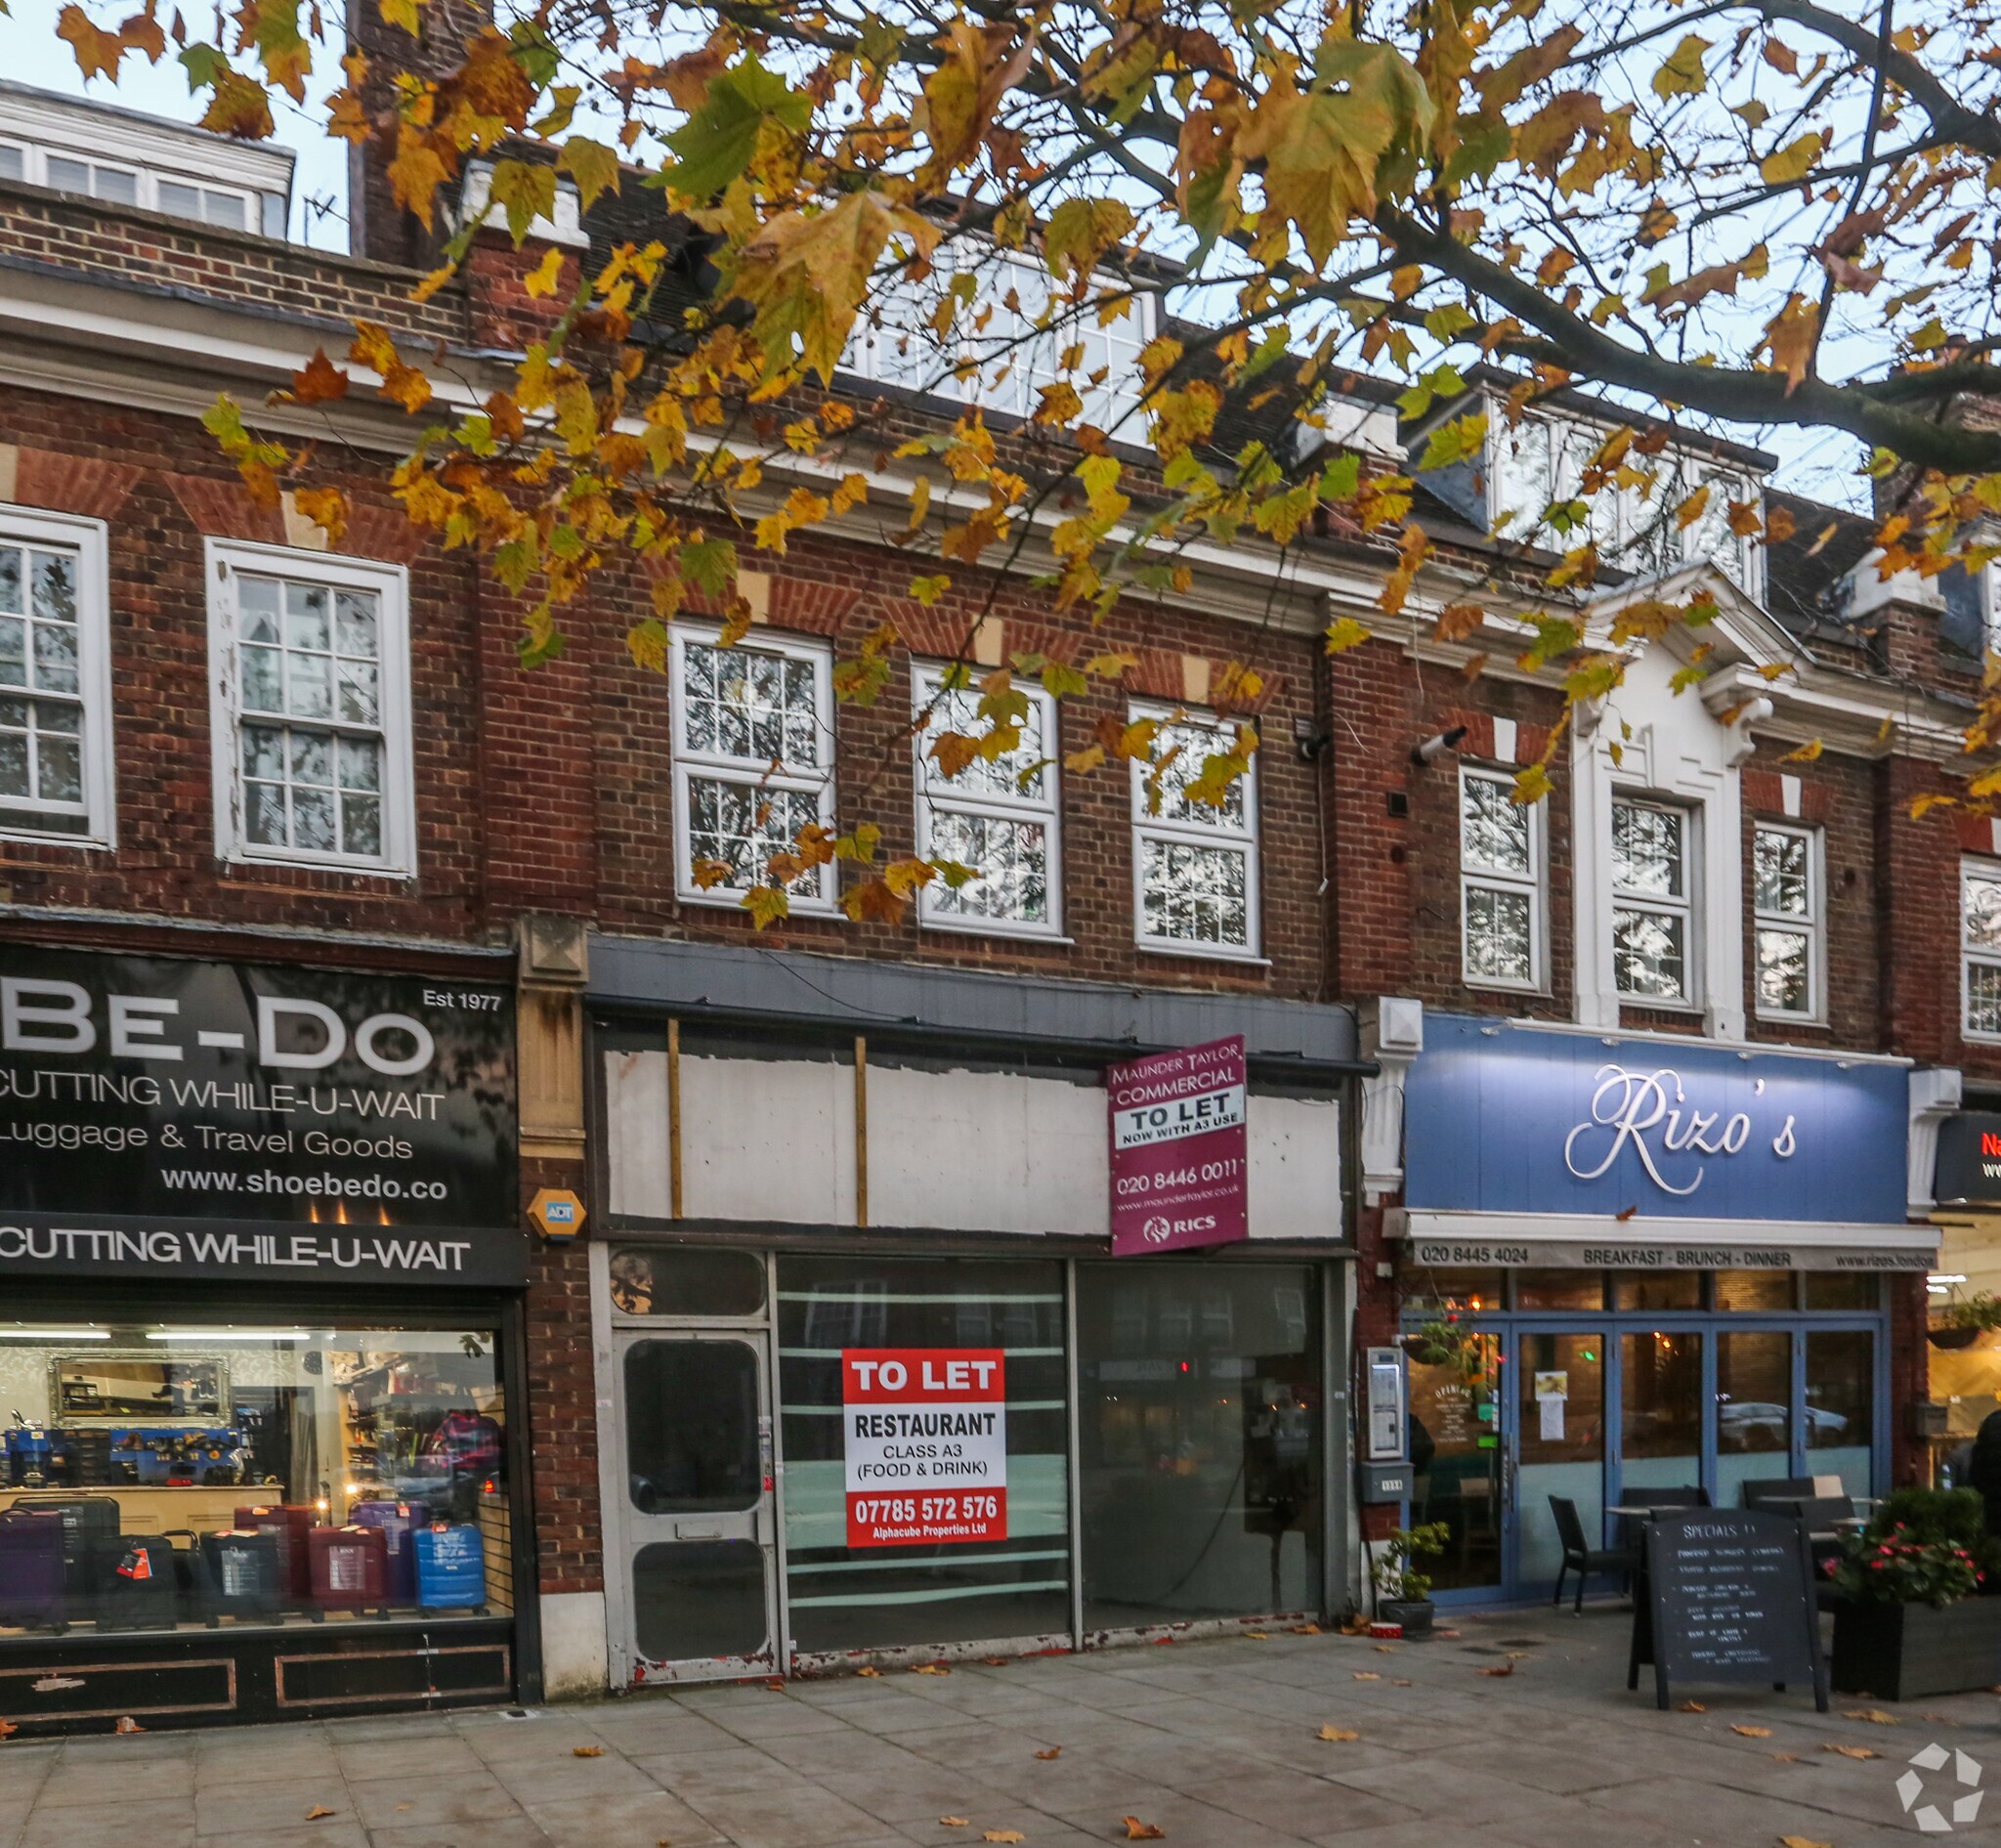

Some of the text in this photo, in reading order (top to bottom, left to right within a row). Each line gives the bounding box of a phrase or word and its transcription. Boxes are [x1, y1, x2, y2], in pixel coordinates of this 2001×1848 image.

[423, 989, 502, 1012] Est 1977
[169, 1078, 446, 1121] WHILE-U-WAIT
[1117, 1067, 1236, 1105] COMMERCIAL
[1130, 1093, 1230, 1131] TO LET
[161, 1125, 186, 1148] &
[194, 1126, 293, 1154] Travel
[304, 1131, 413, 1160] Goods
[1123, 1131, 1152, 1144] NOW
[1157, 1124, 1190, 1139] WITH
[1213, 1112, 1238, 1127] USE
[161, 1168, 447, 1201] www.shoebedo.co
[1117, 1158, 1238, 1195] 020 8446 0011
[547, 1205, 574, 1220] ADT
[1173, 1215, 1216, 1233] RICS
[0, 1226, 471, 1271] CUTTING WHILE-U-WAIT
[1421, 1246, 1449, 1263] 020
[1453, 1247, 1490, 1263] 8445
[1494, 1247, 1529, 1264] 4024
[1584, 1249, 1665, 1266] BREAKFAST
[1677, 1250, 1731, 1266] BRUNCH
[1744, 1251, 1792, 1266] DINNER
[851, 1360, 997, 1391] TO LET
[855, 1412, 996, 1439] RESTAURANT
[883, 1443, 962, 1459] CLASS A3
[858, 1461, 988, 1482] (FOOD & DRINK)
[855, 1495, 998, 1524] 07785 572 576
[873, 1523, 987, 1541] Alphacube Properties Ltd
[1682, 1525, 1738, 1539] SPECIALS
